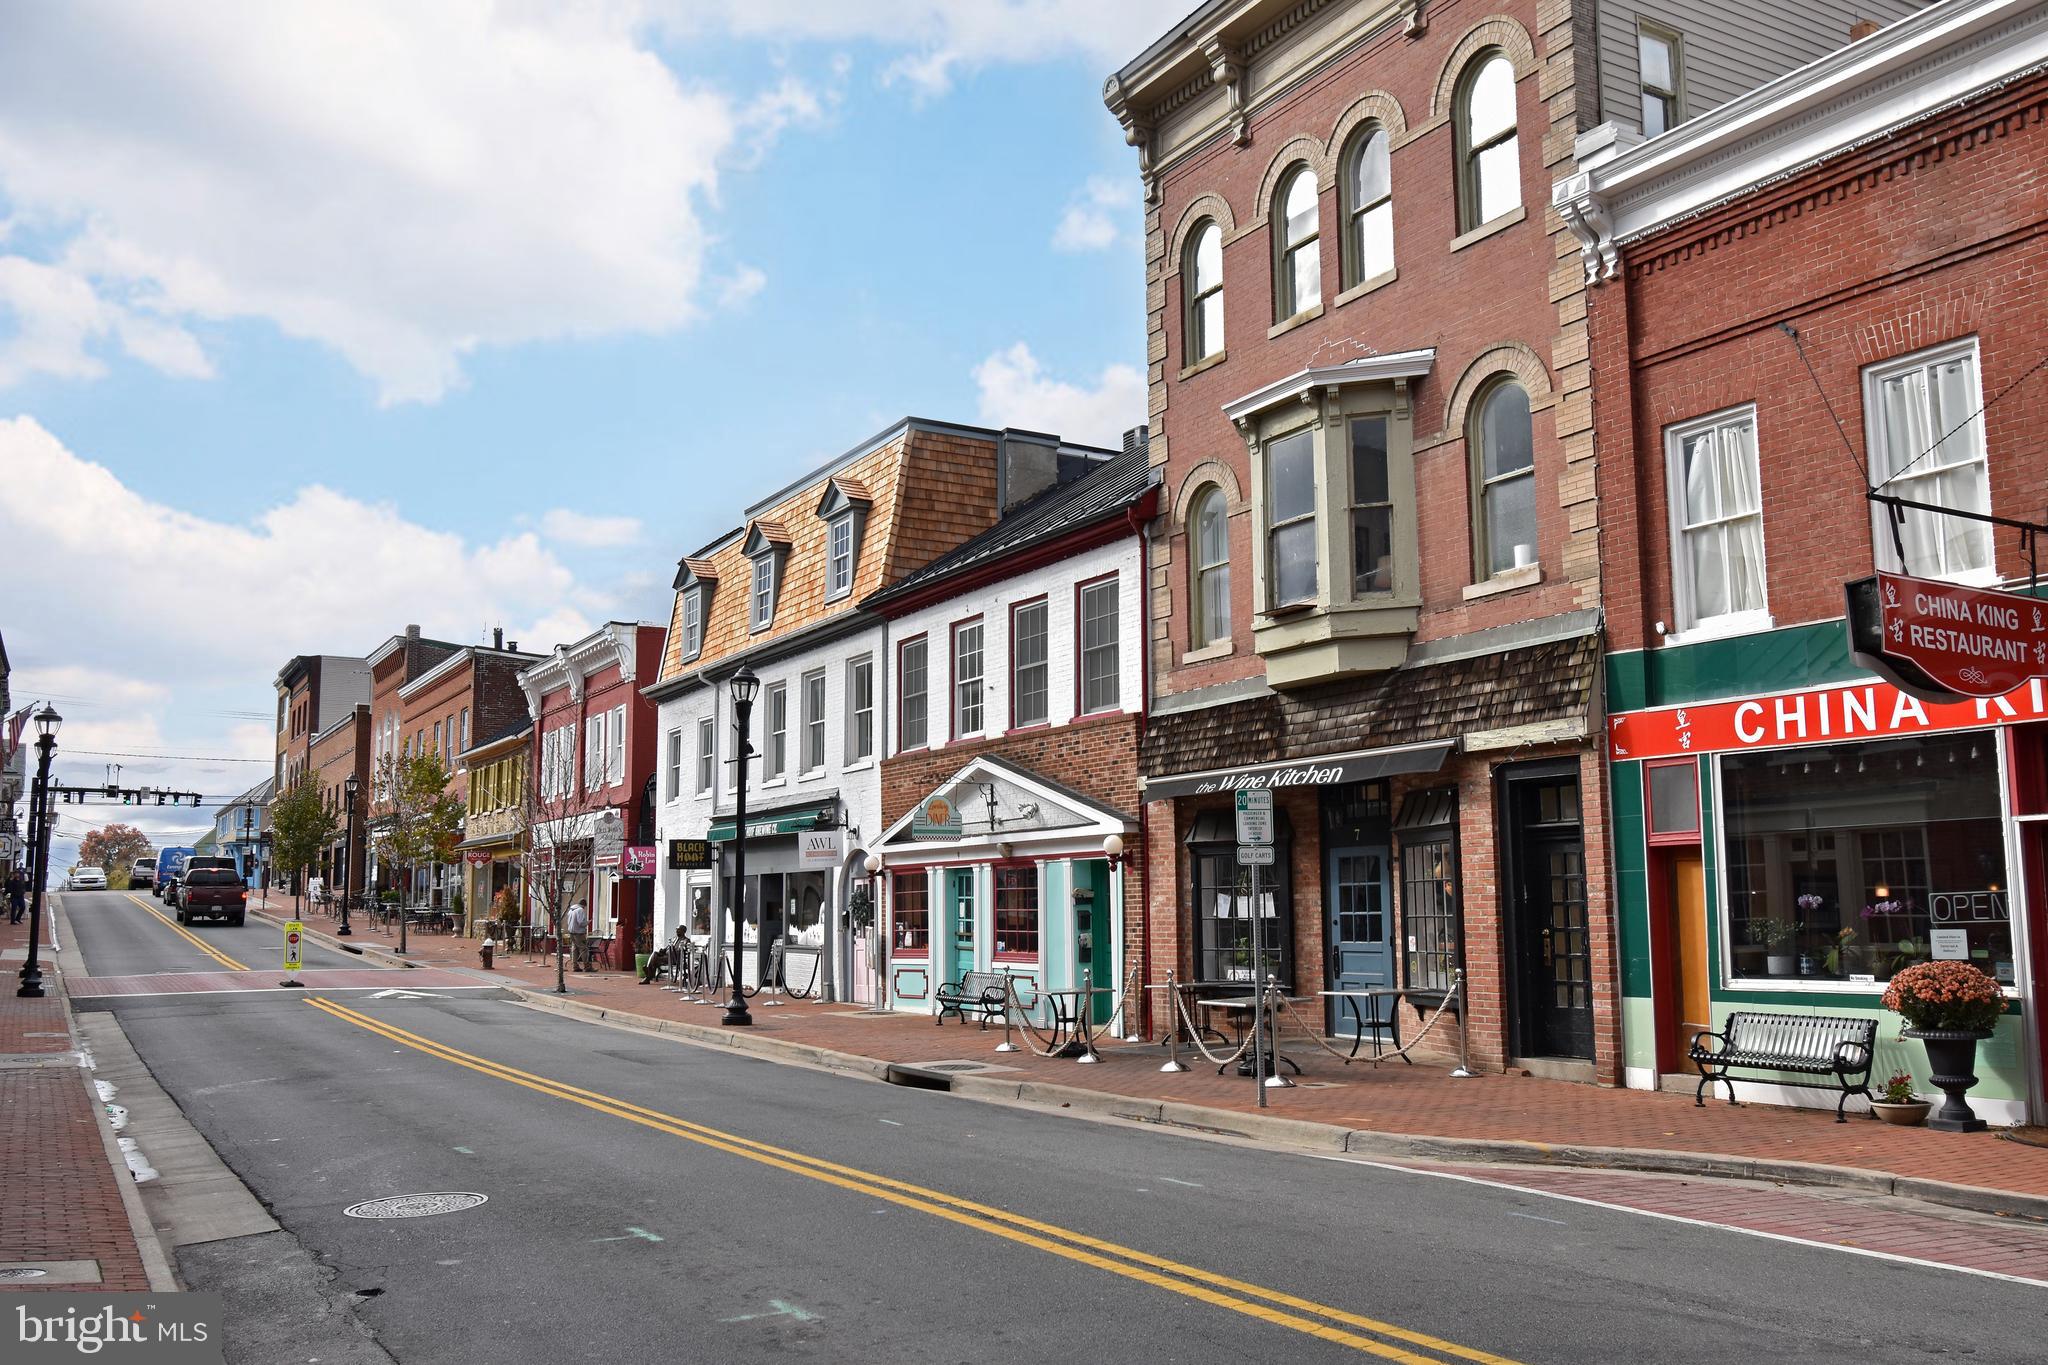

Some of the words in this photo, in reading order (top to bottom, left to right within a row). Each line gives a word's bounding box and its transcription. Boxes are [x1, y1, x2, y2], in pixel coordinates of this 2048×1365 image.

[1915, 593, 1972, 623] CHINA
[1977, 603, 2019, 631] KING
[1910, 624, 2028, 663] RESTAURANT
[1734, 688, 1930, 744] CHINA
[1195, 782, 1216, 794] the
[1218, 773, 1266, 791] Wine
[1266, 765, 1343, 788] Kitchen
[1237, 795, 1247, 806] 20
[1248, 796, 1270, 804] MINUTES
[926, 813, 950, 827] DINER
[807, 837, 836, 850] AWL
[1354, 828, 1360, 841] 7
[676, 842, 705, 852] BLACK
[1933, 893, 2009, 921] OPEN
